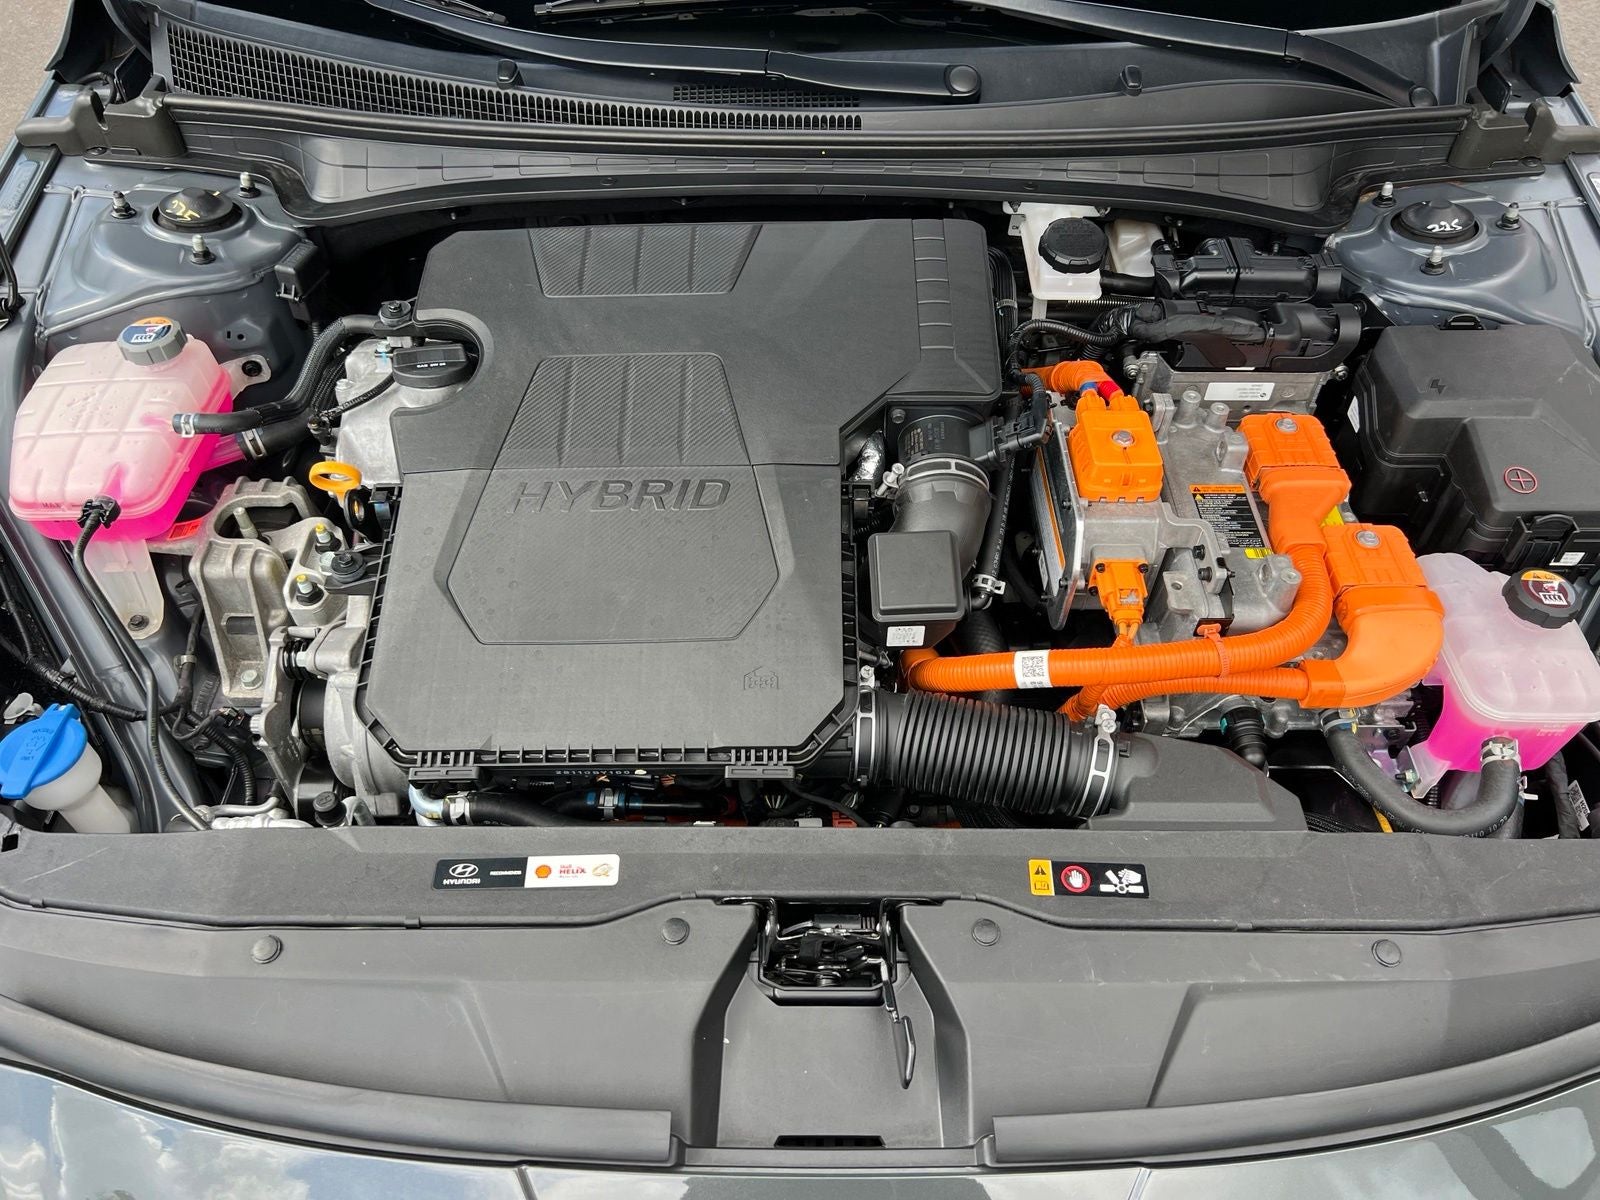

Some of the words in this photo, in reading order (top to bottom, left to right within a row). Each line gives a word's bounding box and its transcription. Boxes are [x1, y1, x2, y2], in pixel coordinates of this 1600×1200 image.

[506, 478, 731, 514] HYBRID
[559, 867, 587, 875] HELIX
[443, 877, 481, 885] HYUNDAI
